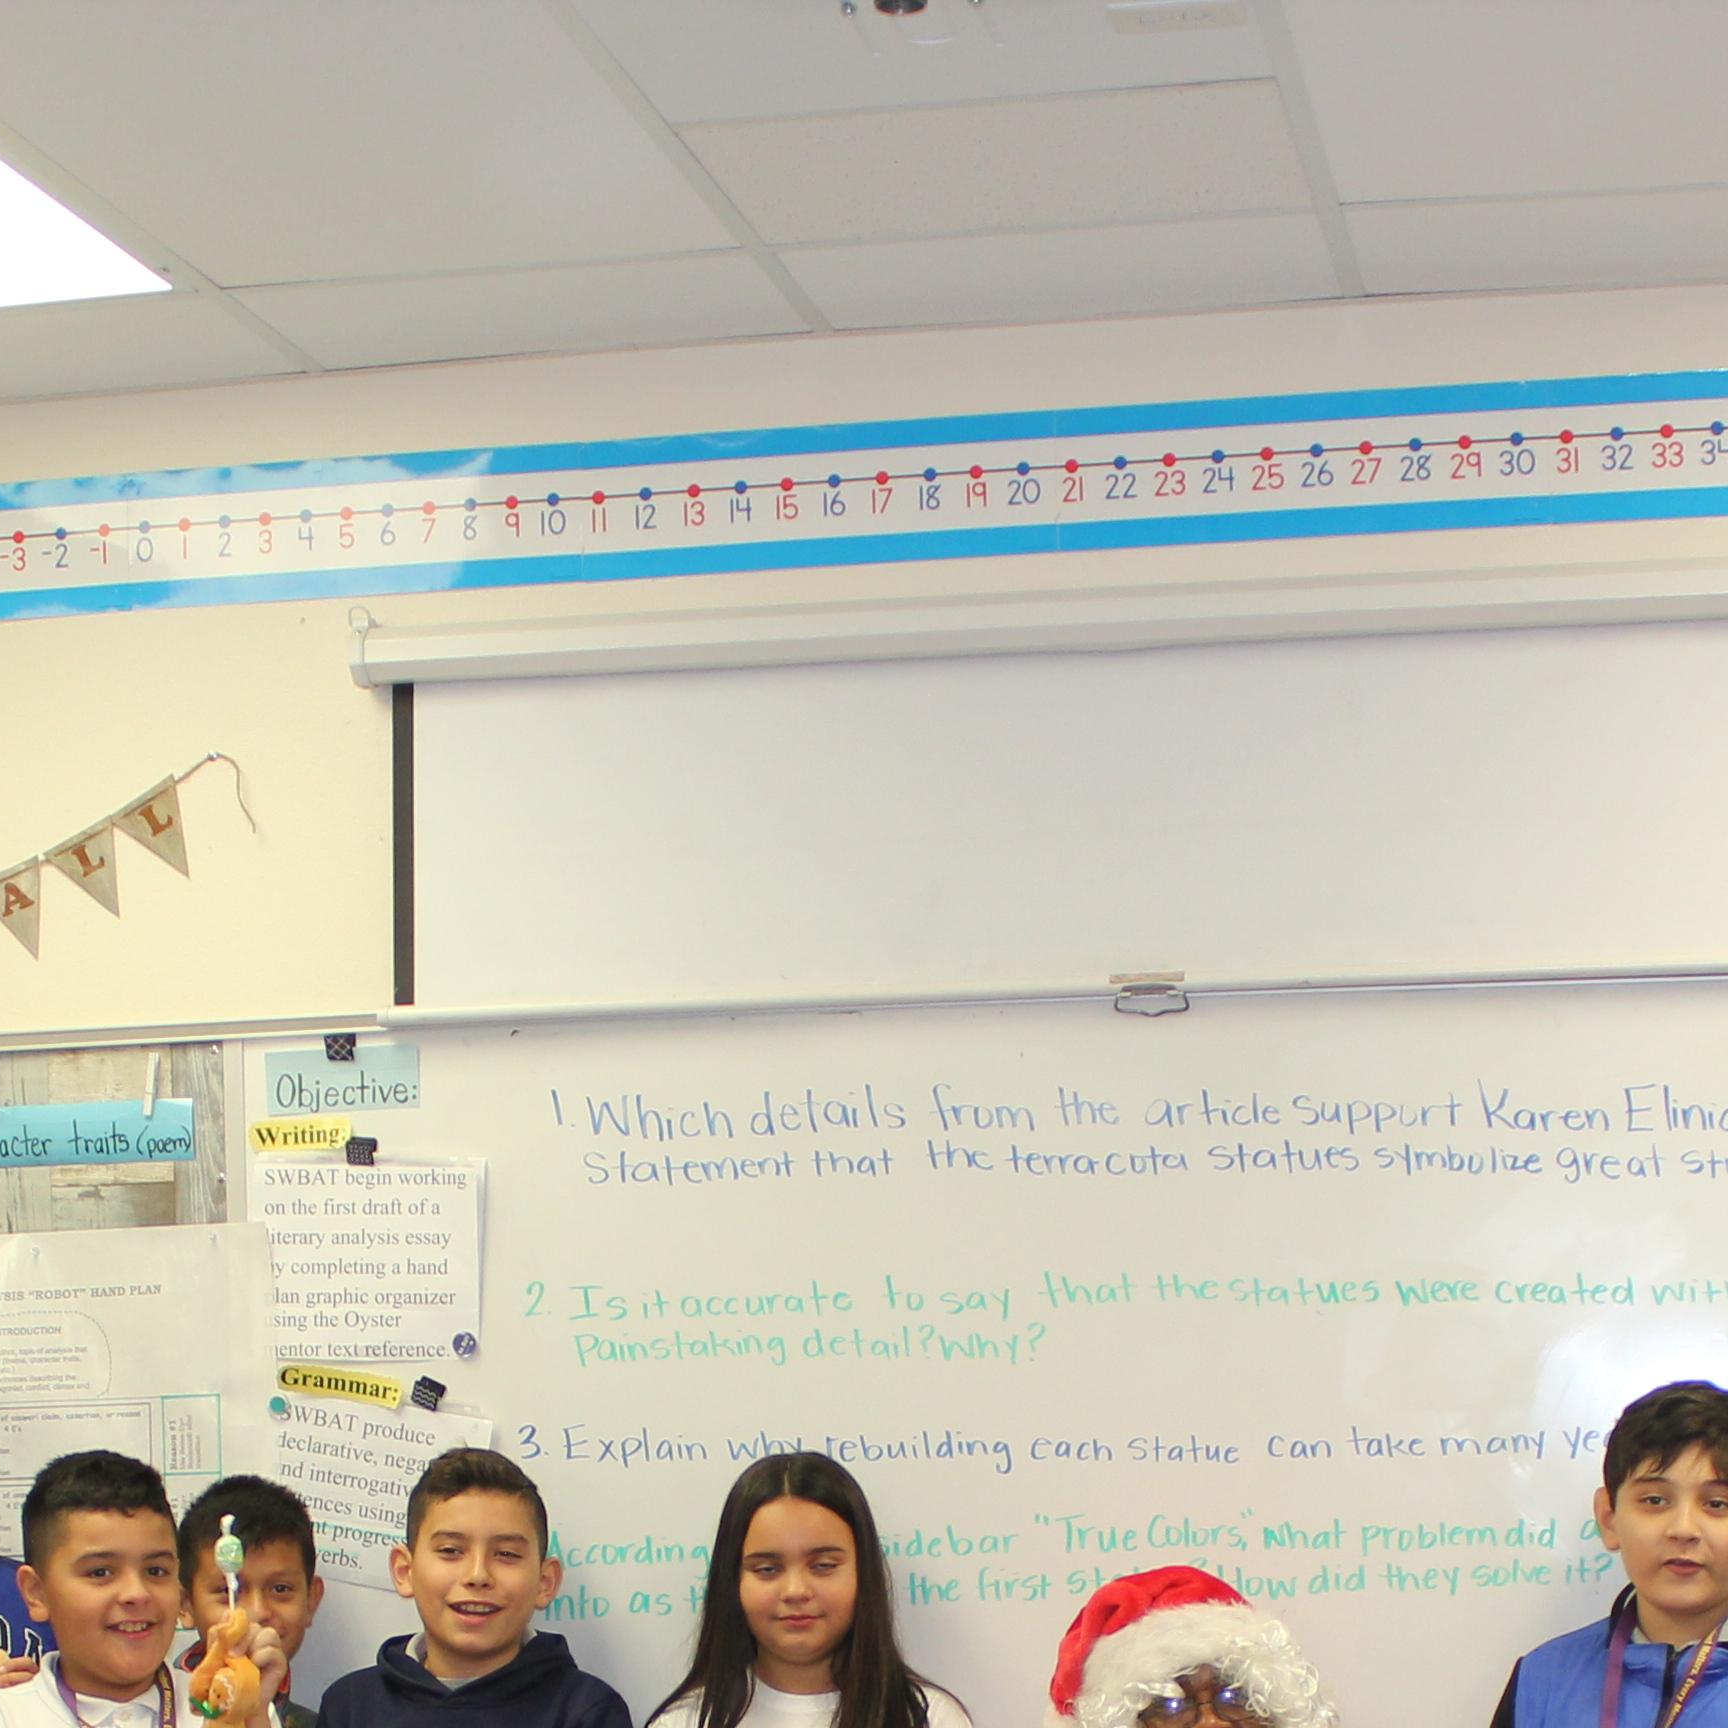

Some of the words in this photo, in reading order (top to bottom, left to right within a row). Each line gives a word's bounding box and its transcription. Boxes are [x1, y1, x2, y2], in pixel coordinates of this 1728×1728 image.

[541, 509, 566, 535] 10
[919, 484, 941, 510] 18
[1301, 460, 1333, 488] 26
[1652, 441, 1683, 468] 33
[276, 1074, 418, 1112] Objective:
[587, 1094, 733, 1142] Which
[751, 1084, 906, 1136] details
[932, 1084, 1035, 1131] from
[1058, 1087, 1119, 1126] the
[1146, 1089, 1280, 1127] article
[1478, 1080, 1609, 1131] Karen
[68, 1118, 130, 1156] traits
[137, 1123, 192, 1158] (poem)
[264, 1168, 341, 1188] SWBAT
[343, 1168, 393, 1191] begin
[399, 1169, 466, 1190] working
[815, 1149, 892, 1176] that
[928, 1140, 993, 1170] the
[1008, 1145, 1188, 1175] terracota
[1374, 1144, 1542, 1176] symbolize
[1556, 1145, 1661, 1183] great
[362, 1198, 402, 1215] draft
[331, 1228, 399, 1249] analysis
[405, 1233, 451, 1249] essay
[291, 1258, 386, 1279] completing
[306, 1286, 370, 1311] graphic
[374, 1285, 456, 1311] organizer
[570, 1285, 628, 1321] Is
[885, 1275, 924, 1311] to
[940, 1288, 1009, 1321] say
[1044, 1271, 1134, 1307] that
[1156, 1274, 1218, 1300] the
[1495, 1273, 1633, 1303] created
[803, 1324, 936, 1359] detail?
[281, 1367, 399, 1402] Grammar:
[563, 1428, 707, 1468] Explain
[1031, 1439, 1112, 1460] each
[1267, 1436, 1331, 1458] can
[1350, 1426, 1424, 1457] take
[1440, 1425, 1552, 1459] many
[1362, 1523, 1497, 1555] problem
[1380, 1563, 1460, 1596] they
[1472, 1559, 1551, 1587] solve
